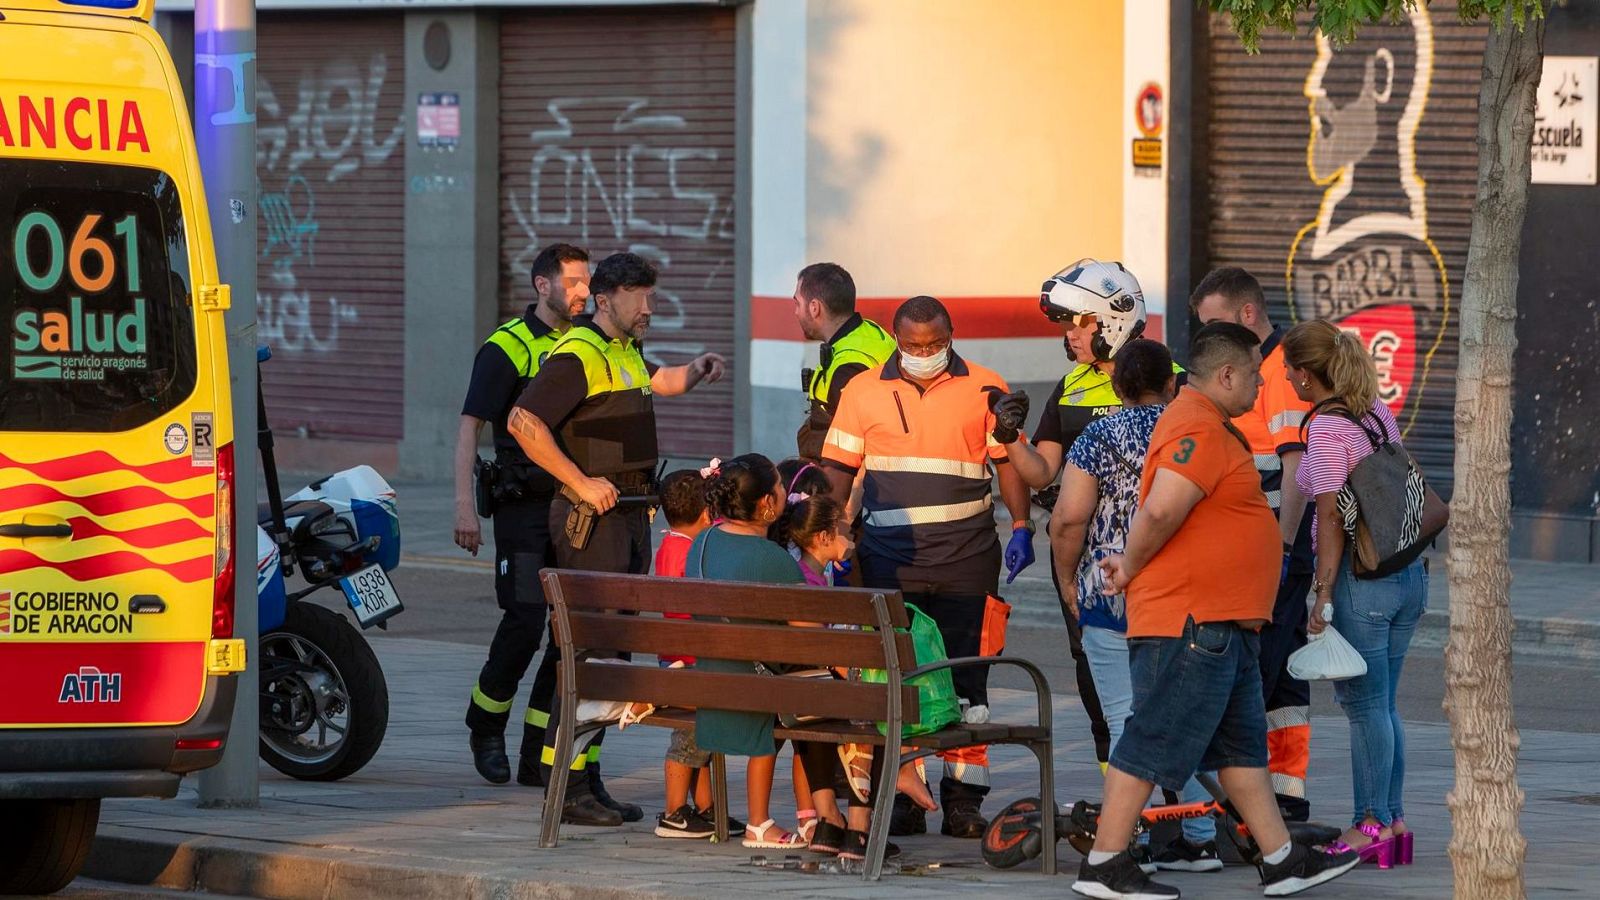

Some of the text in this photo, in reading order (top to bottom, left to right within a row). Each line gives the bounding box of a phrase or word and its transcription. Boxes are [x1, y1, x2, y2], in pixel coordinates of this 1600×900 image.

[15, 212, 140, 292] 061
[1313, 249, 1417, 321] BARBA
[15, 297, 146, 353] salud
[63, 355, 147, 371] servicio aragonés
[63, 368, 105, 380] de salud
[1173, 437, 1196, 465] 3
[352, 568, 386, 595] 4938
[14, 591, 120, 612] GOBIERNO
[360, 589, 389, 614] KDR
[13, 614, 133, 634] DE ARAGON
[58, 672, 121, 703] ATH
